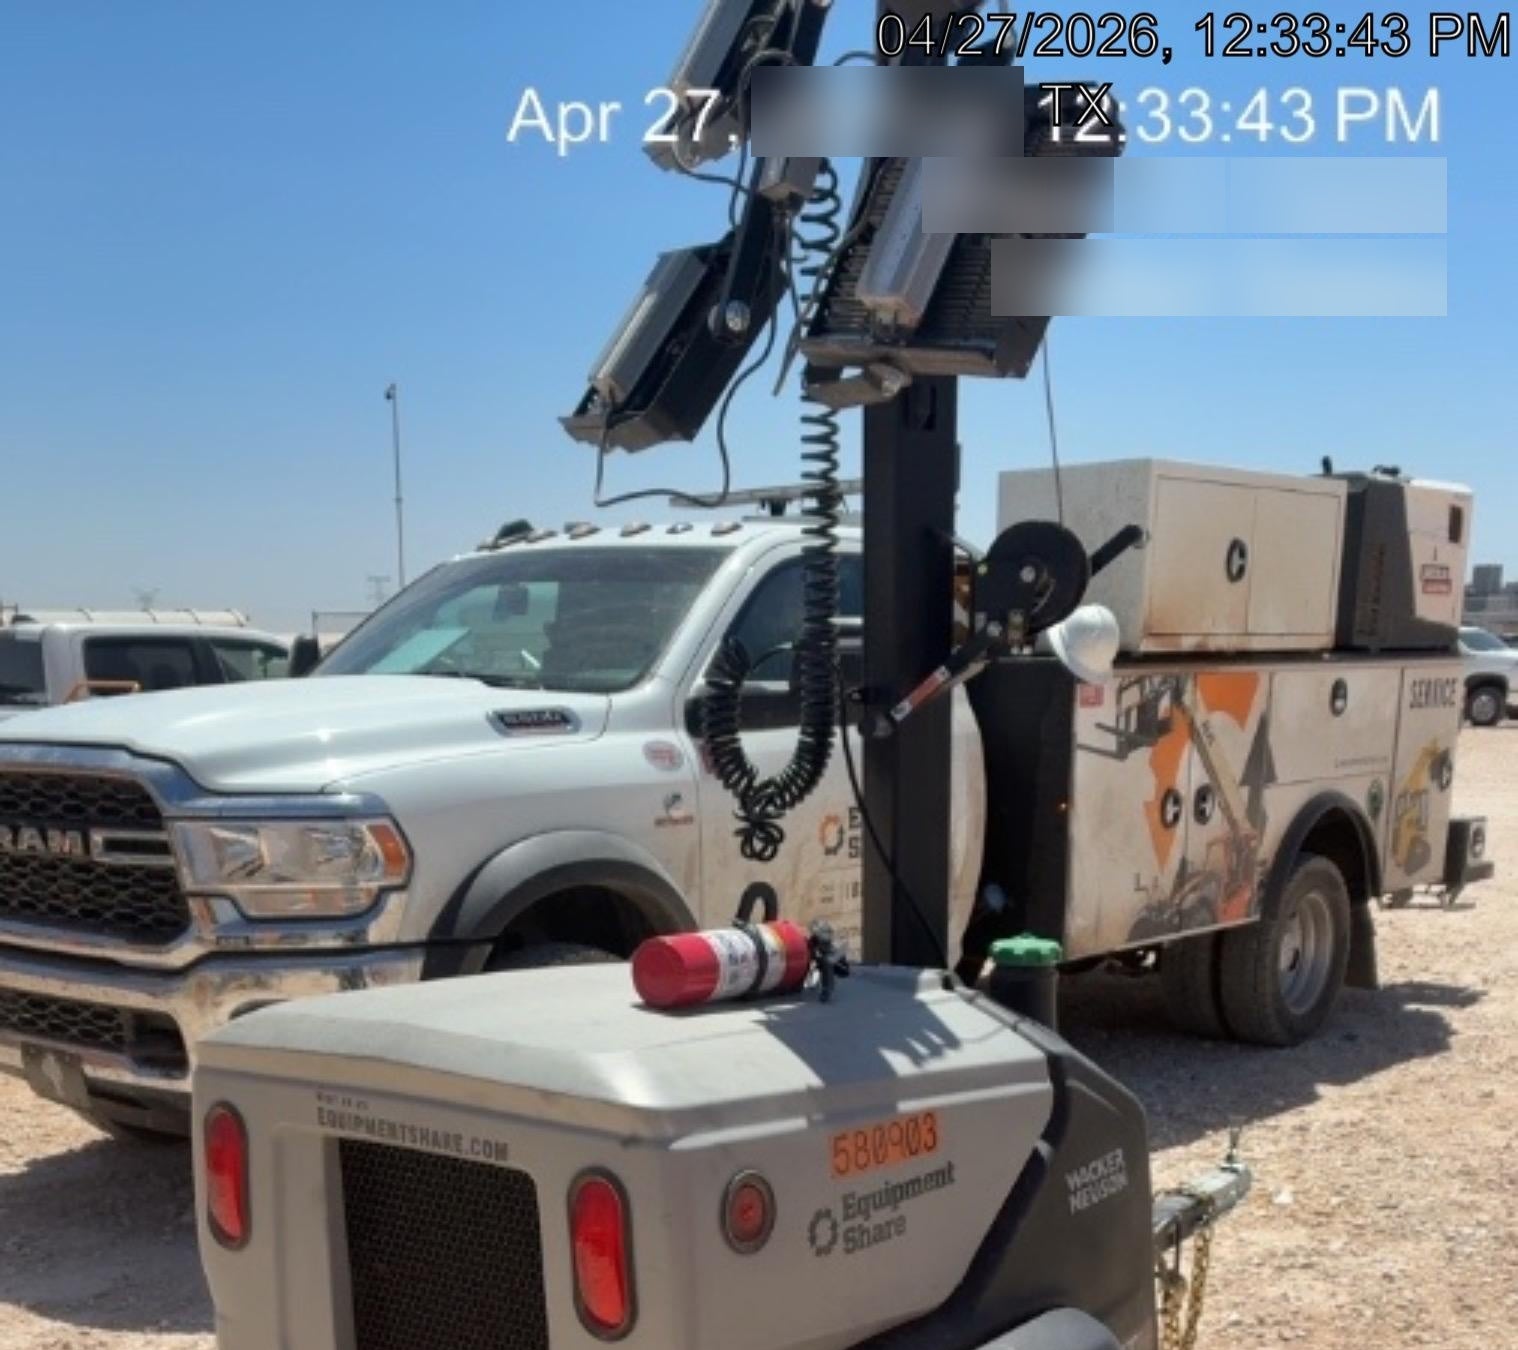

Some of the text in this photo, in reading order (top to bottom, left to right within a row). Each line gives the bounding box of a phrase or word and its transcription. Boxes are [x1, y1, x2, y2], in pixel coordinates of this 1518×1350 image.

[1409, 676, 1458, 710] SERVICE
[316, 1105, 510, 1162] EQUIPMENTSHARE.COM
[832, 1110, 937, 1176] 580903
[841, 1160, 955, 1222] Equipment
[1064, 1147, 1124, 1193] WACKER
[1068, 1174, 1129, 1216] NEUSON
[841, 1213, 907, 1255] Share
